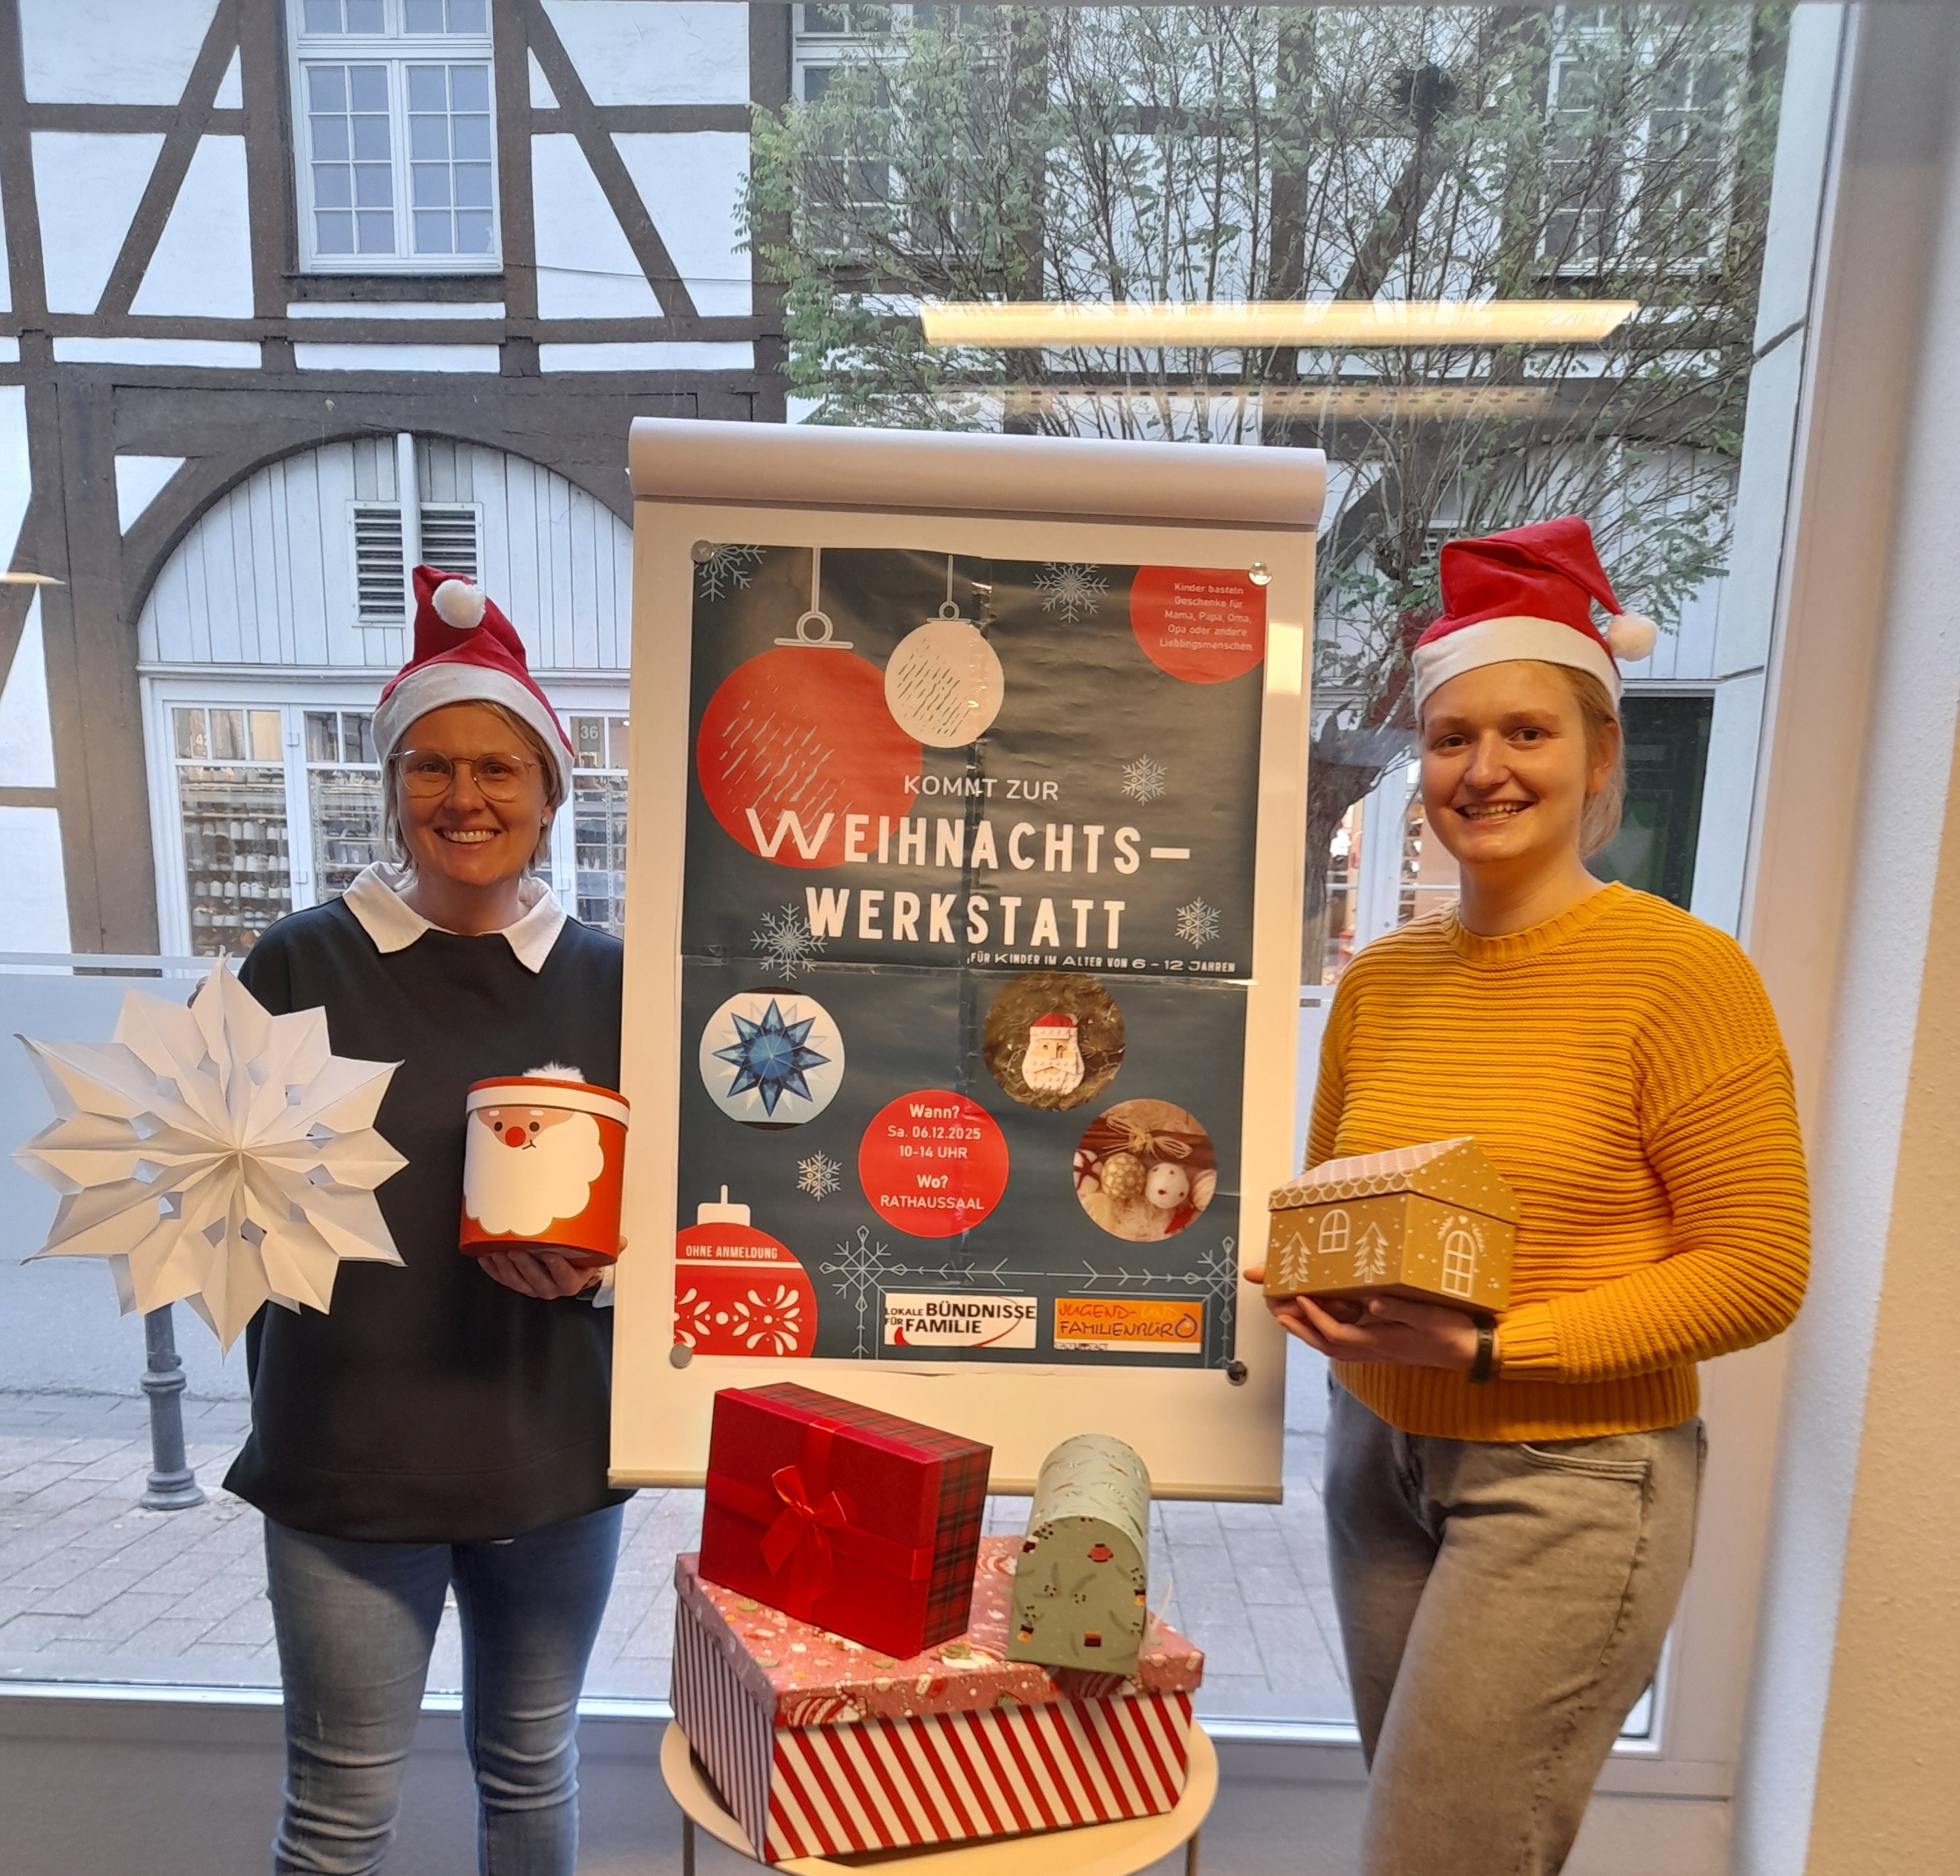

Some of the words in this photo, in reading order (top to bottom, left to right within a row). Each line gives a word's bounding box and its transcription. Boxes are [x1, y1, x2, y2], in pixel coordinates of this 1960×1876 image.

[1174, 583, 1206, 592] Kinder
[1208, 585, 1244, 594] basteln
[1174, 596, 1226, 607] Geschenke
[1164, 609, 1196, 621] Mama,
[1199, 611, 1225, 623] Papa,
[1228, 613, 1252, 624] Oma,
[1168, 624, 1186, 634] Opa
[1188, 626, 1211, 635] oder
[1213, 628, 1247, 637] andere
[580, 724, 598, 740] 36
[904, 774, 998, 798] KOMMT
[1005, 779, 1059, 801] ZUR
[805, 886, 1126, 950] WERKSTATT
[994, 953, 1040, 965] KINDER
[1044, 955, 1057, 965] IM
[1061, 956, 1103, 967] ALTER
[1107, 957, 1128, 969] VON
[1132, 958, 1146, 969] 6
[1164, 960, 1184, 971] 12
[1188, 960, 1236, 973] JAHREN
[909, 1103, 960, 1119] Wann?
[887, 1125, 909, 1138] Sa.
[912, 1125, 981, 1140] 06.12.2025
[938, 1146, 968, 1159] UHR
[917, 1174, 949, 1189] Wo?
[880, 1194, 985, 1210] RATHAUSSAAL
[685, 1244, 713, 1257] OHNE
[715, 1246, 779, 1260] ANMELDUNG
[885, 1308, 924, 1317] LOKALE
[926, 1301, 1036, 1320] BÜNDNISSE
[1059, 1303, 1136, 1320] JUGEND-
[885, 1316, 904, 1327] FÜR
[906, 1318, 983, 1334] FAMILIE
